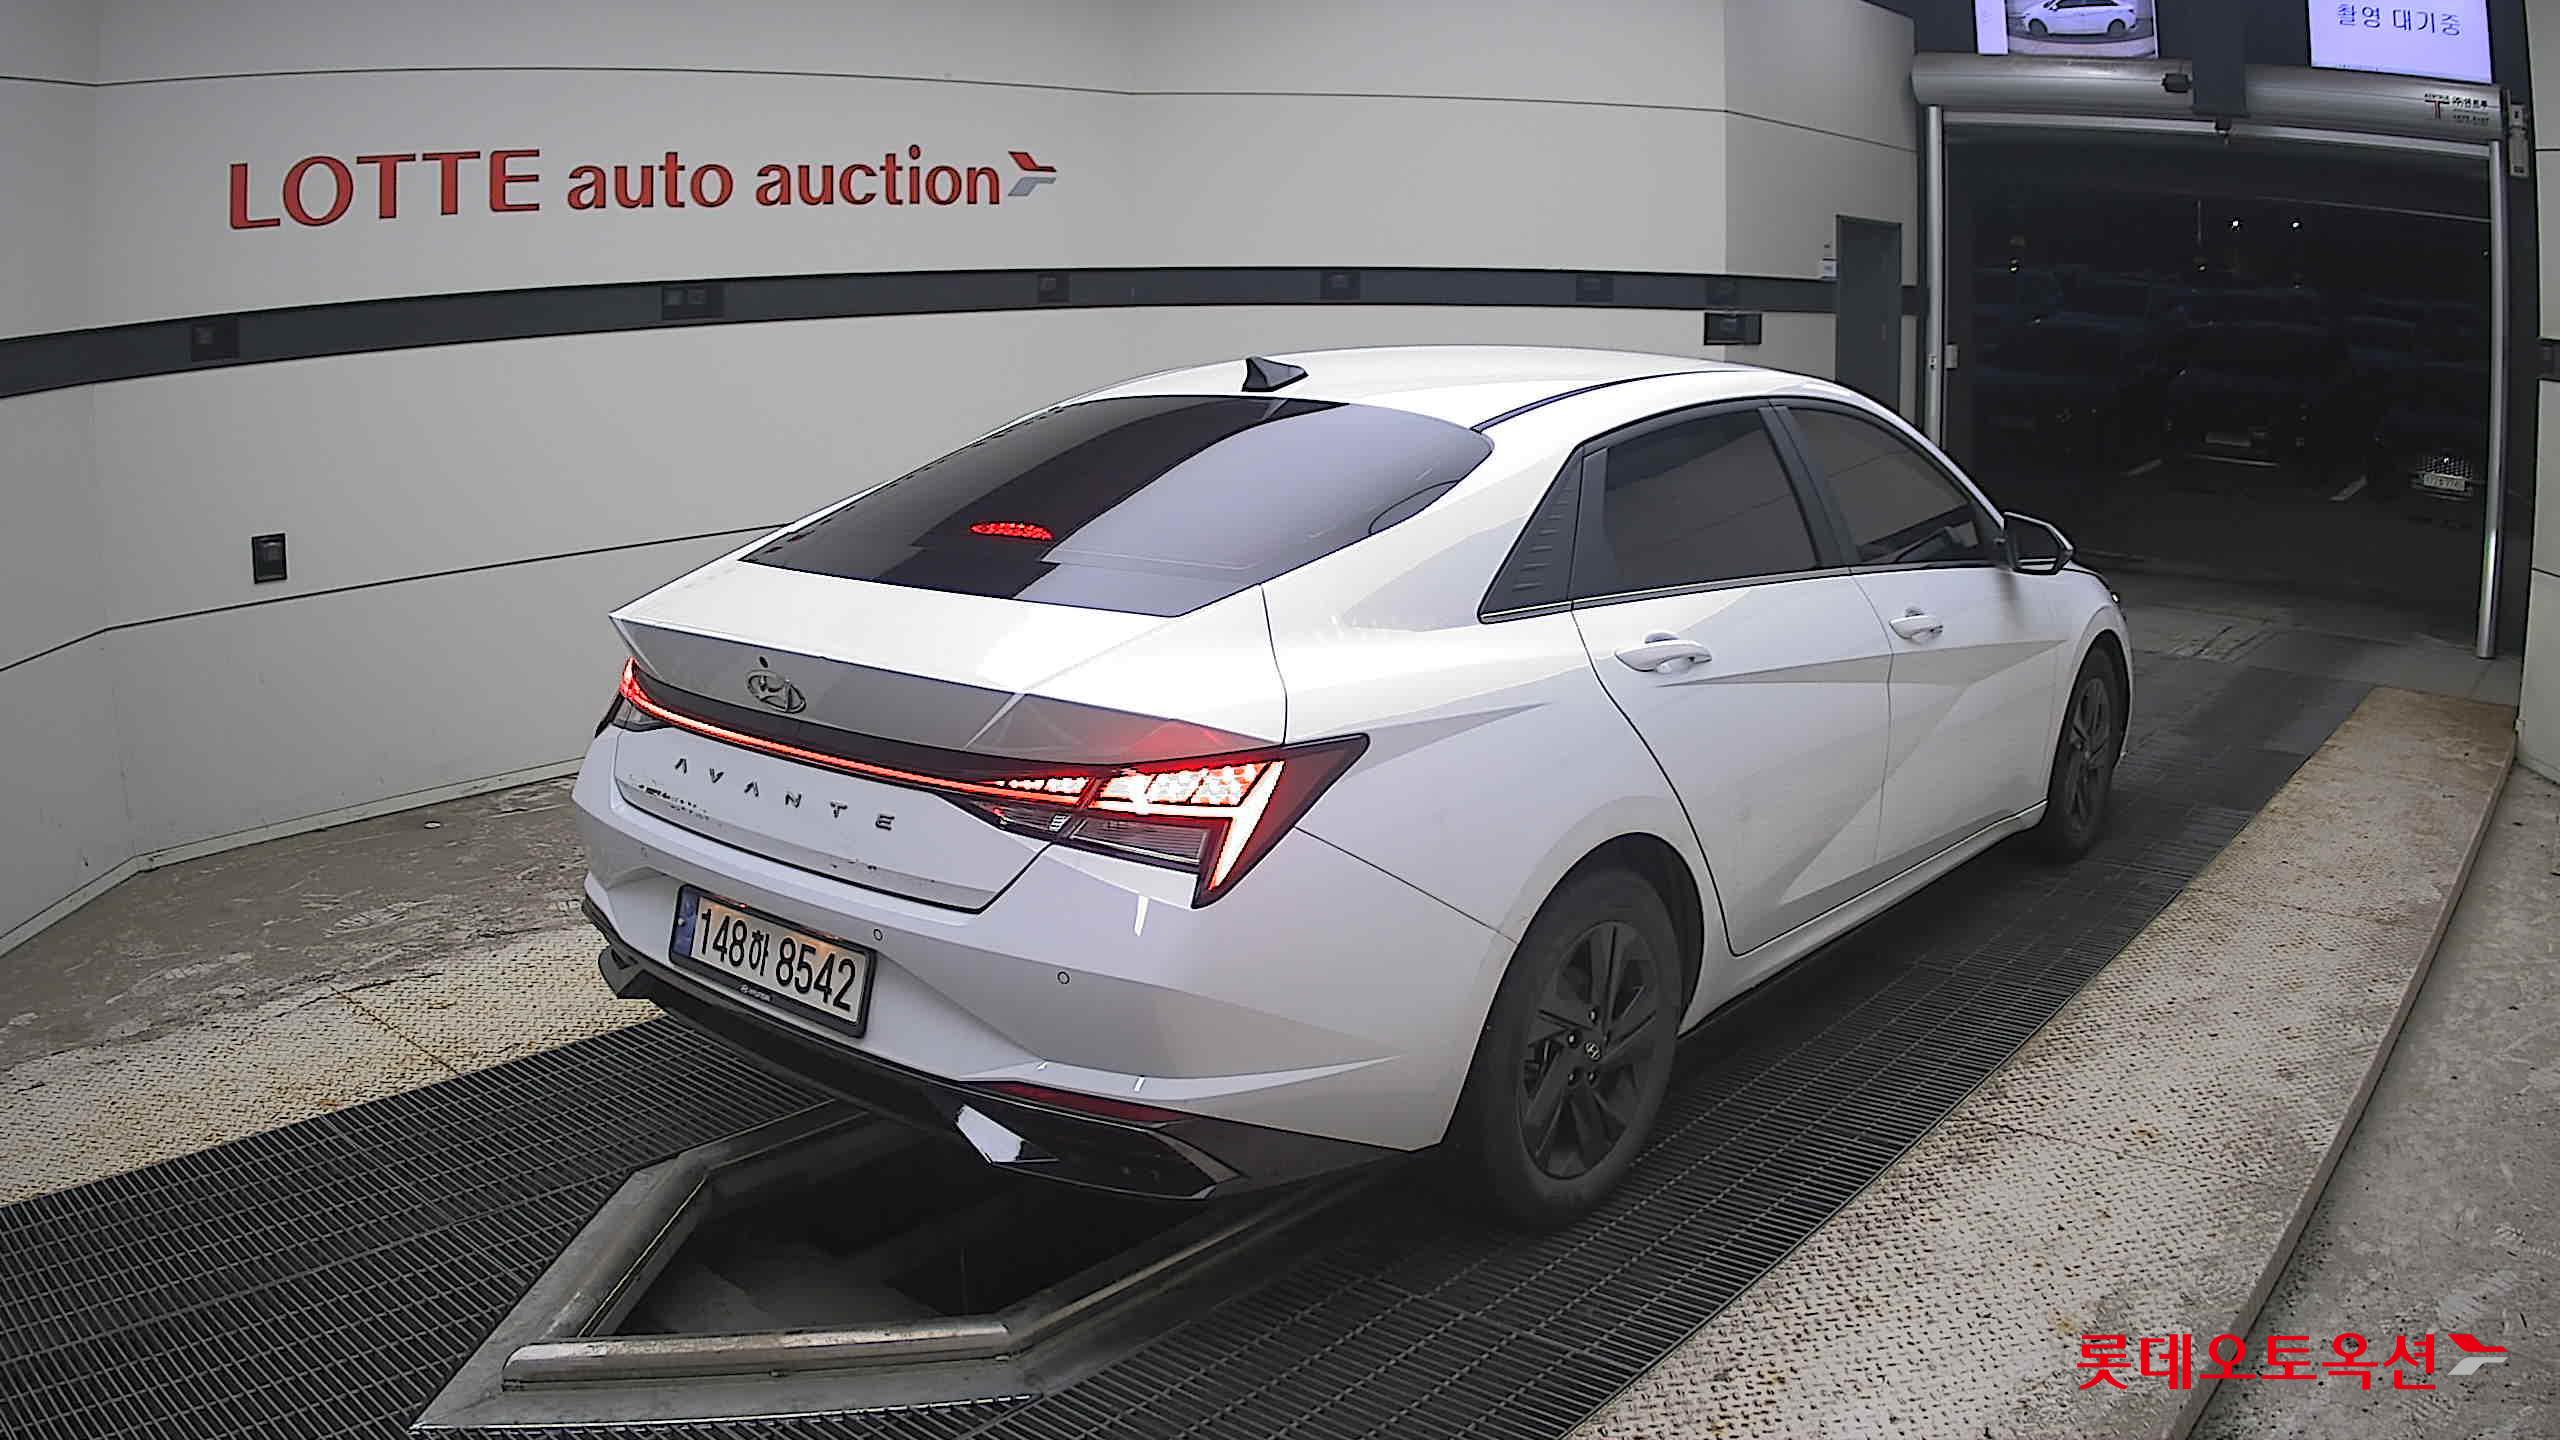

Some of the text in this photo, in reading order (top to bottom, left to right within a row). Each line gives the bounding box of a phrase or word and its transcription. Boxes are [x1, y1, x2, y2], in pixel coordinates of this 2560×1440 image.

[2337, 3, 2461, 36] 촬영 대기중
[229, 145, 1001, 229] LOTTE auto auction
[674, 758, 896, 831] AVANTE
[701, 908, 856, 1012] 148하 8542
